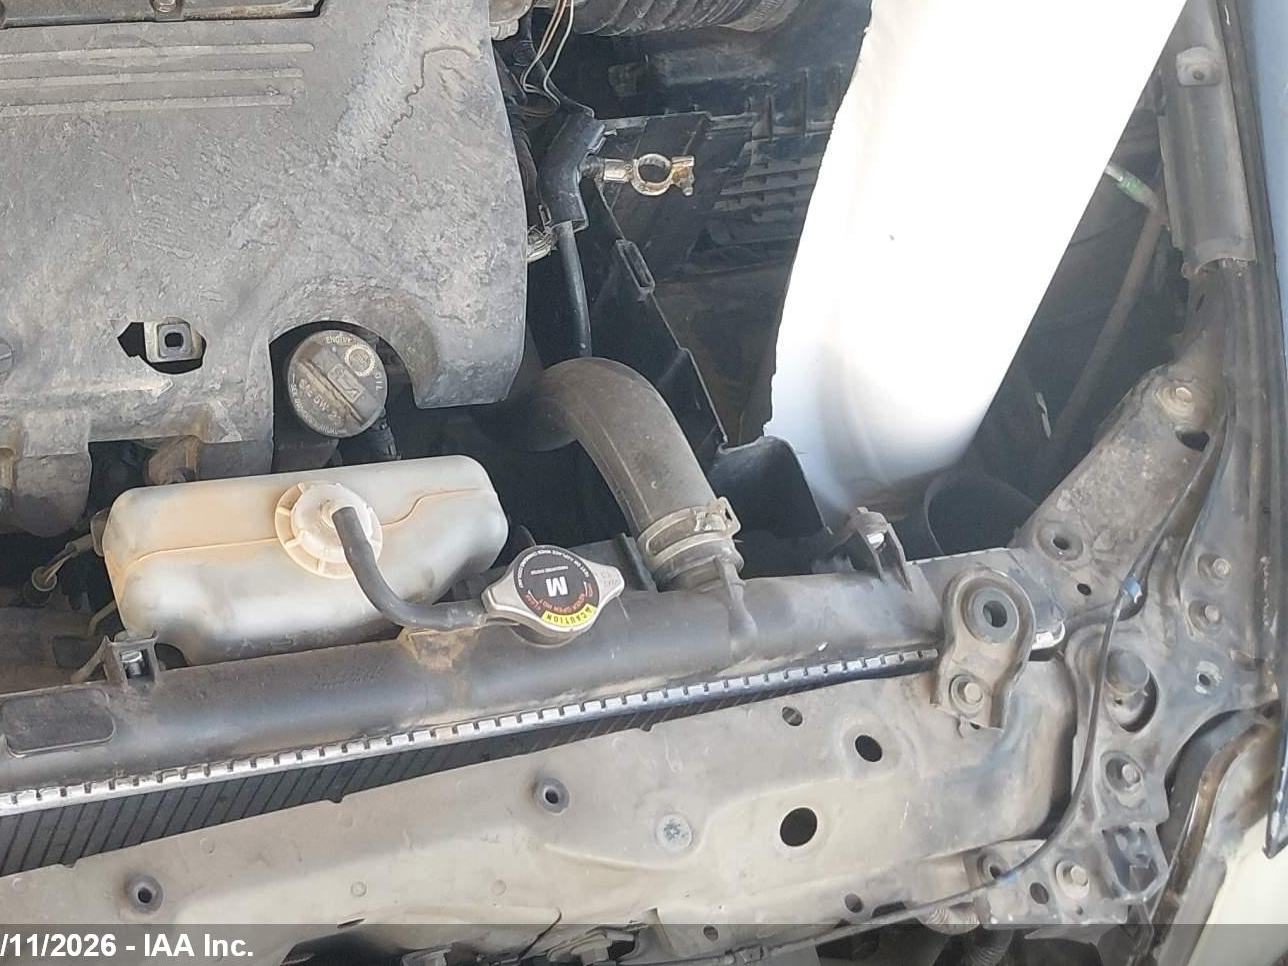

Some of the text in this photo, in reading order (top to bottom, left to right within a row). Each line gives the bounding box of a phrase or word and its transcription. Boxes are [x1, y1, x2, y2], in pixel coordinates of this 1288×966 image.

[375, 372, 384, 391] OIL
[545, 576, 569, 597] M
[546, 612, 589, 625] CAUTION
